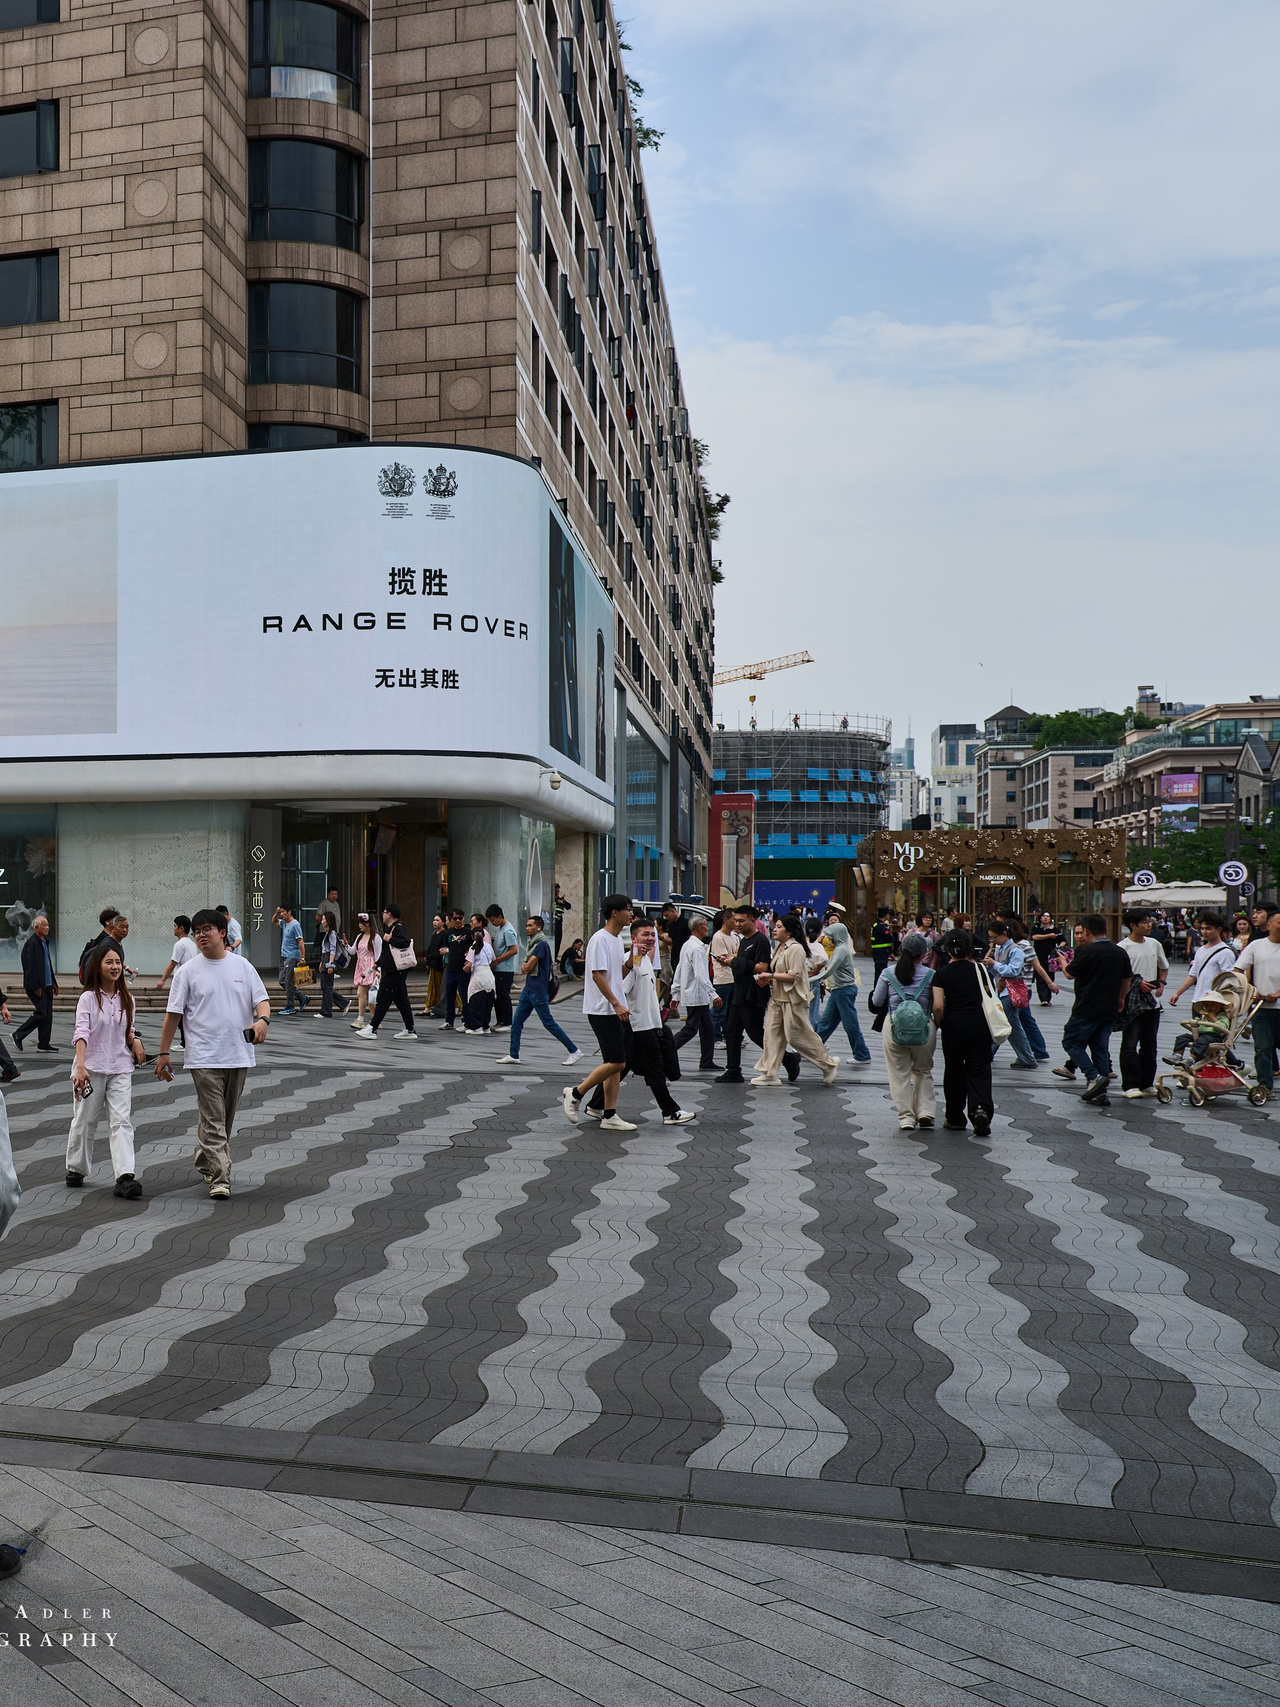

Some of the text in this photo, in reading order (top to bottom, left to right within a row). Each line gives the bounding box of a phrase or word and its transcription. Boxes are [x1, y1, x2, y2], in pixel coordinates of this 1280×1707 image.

[388, 567, 449, 596] 揽胜
[262, 612, 529, 641] RANGE ROVER
[374, 668, 460, 690] 无出其胜
[252, 870, 264, 931] 花西子
